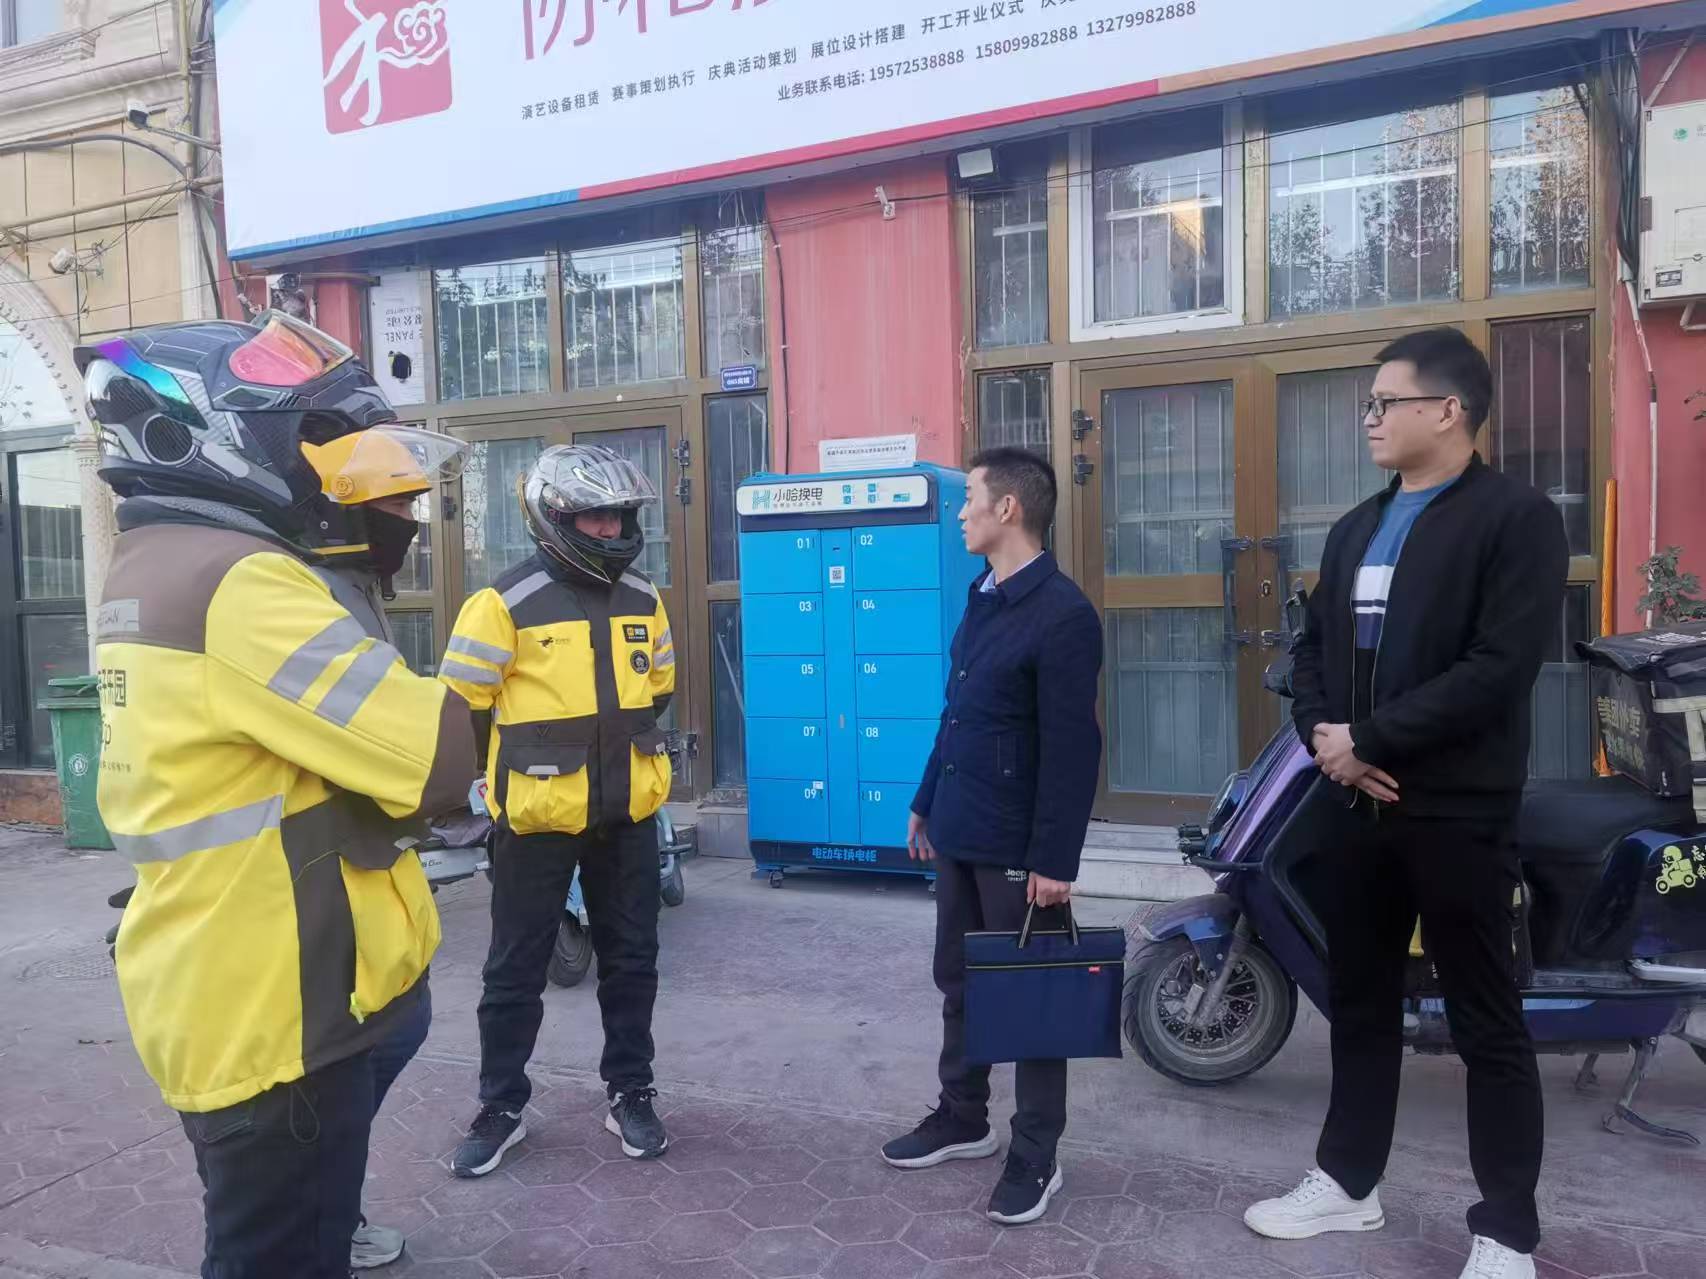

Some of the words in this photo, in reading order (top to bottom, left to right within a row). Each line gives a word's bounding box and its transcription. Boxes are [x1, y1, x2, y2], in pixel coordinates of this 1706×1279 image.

[777, 69, 865, 101] 业务联系电话:
[869, 49, 965, 83] 19572538888
[975, 25, 1079, 60] 15809982888
[1086, 0, 1197, 37] 13279982888
[521, 91, 600, 120] 演艺设备租赁
[611, 70, 695, 101] 赛事策划执行
[708, 48, 797, 80] 庆典活动策划
[811, 24, 905, 58] 展位设计搭建
[921, 0, 1024, 34] 开工开业仪式
[773, 486, 823, 503] 小哈换电
[797, 537, 810, 549] 01
[860, 534, 873, 546] 02
[799, 600, 812, 612] 03
[862, 599, 875, 611] 04
[801, 663, 814, 675] 05
[864, 662, 877, 674] 06
[803, 726, 816, 737] 07
[866, 727, 879, 738] 08
[804, 788, 817, 800] 09
[868, 790, 881, 802] 10
[811, 846, 877, 863] 电动车换电柜
[1005, 868, 1027, 878] Jeep
